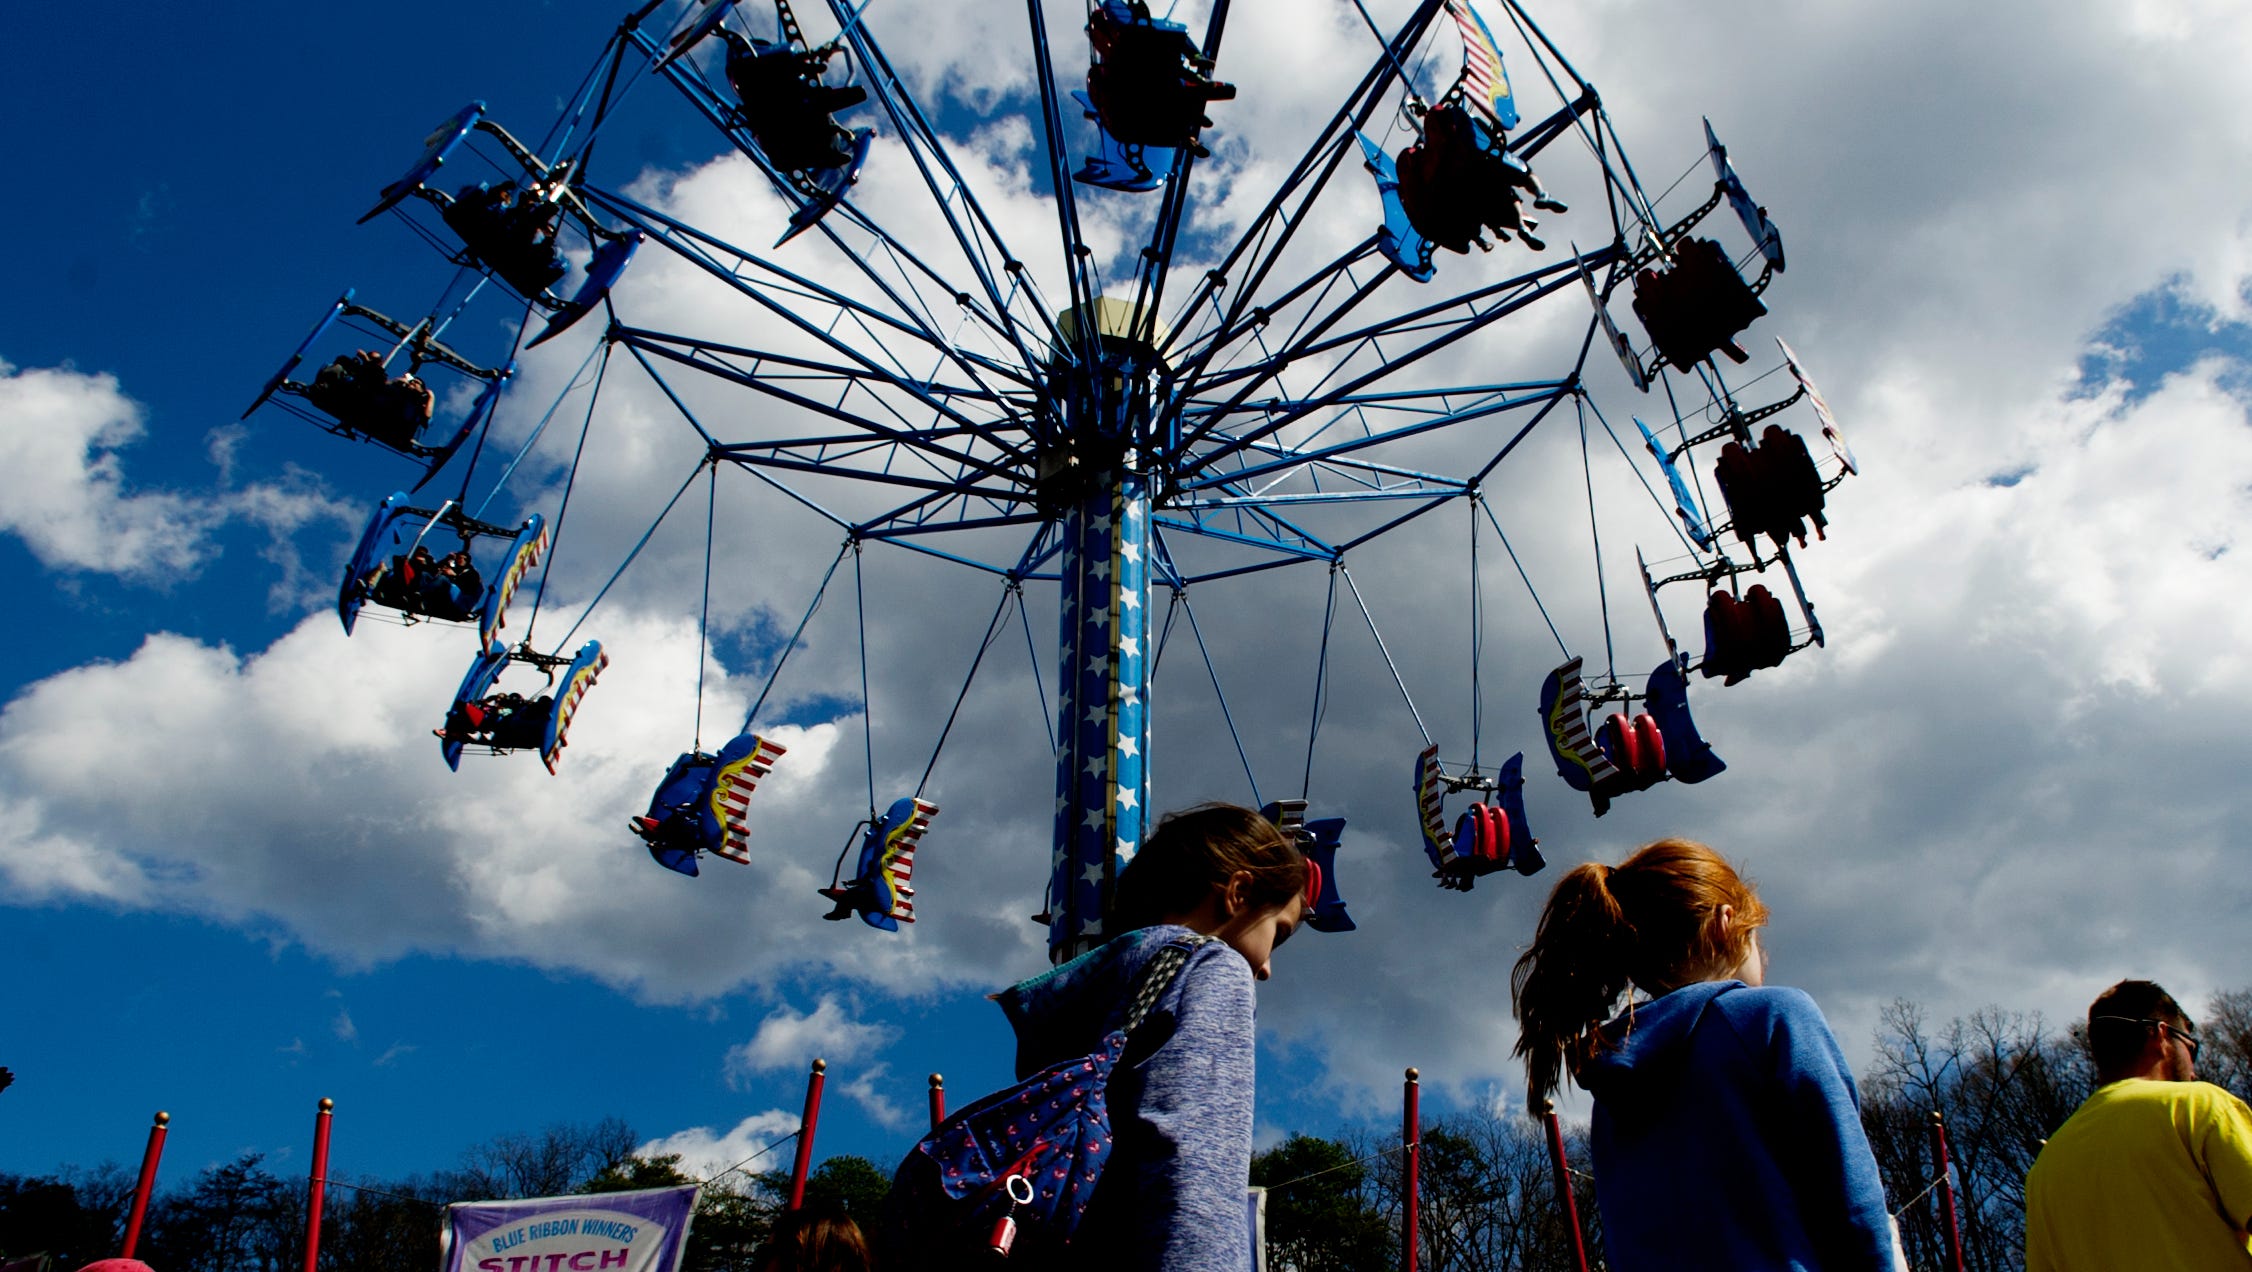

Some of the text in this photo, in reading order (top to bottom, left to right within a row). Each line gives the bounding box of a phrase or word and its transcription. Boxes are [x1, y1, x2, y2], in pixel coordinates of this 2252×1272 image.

[492, 1219, 638, 1253] BLUE RIBBON WINNERS
[478, 1249, 629, 1272] STITCH
